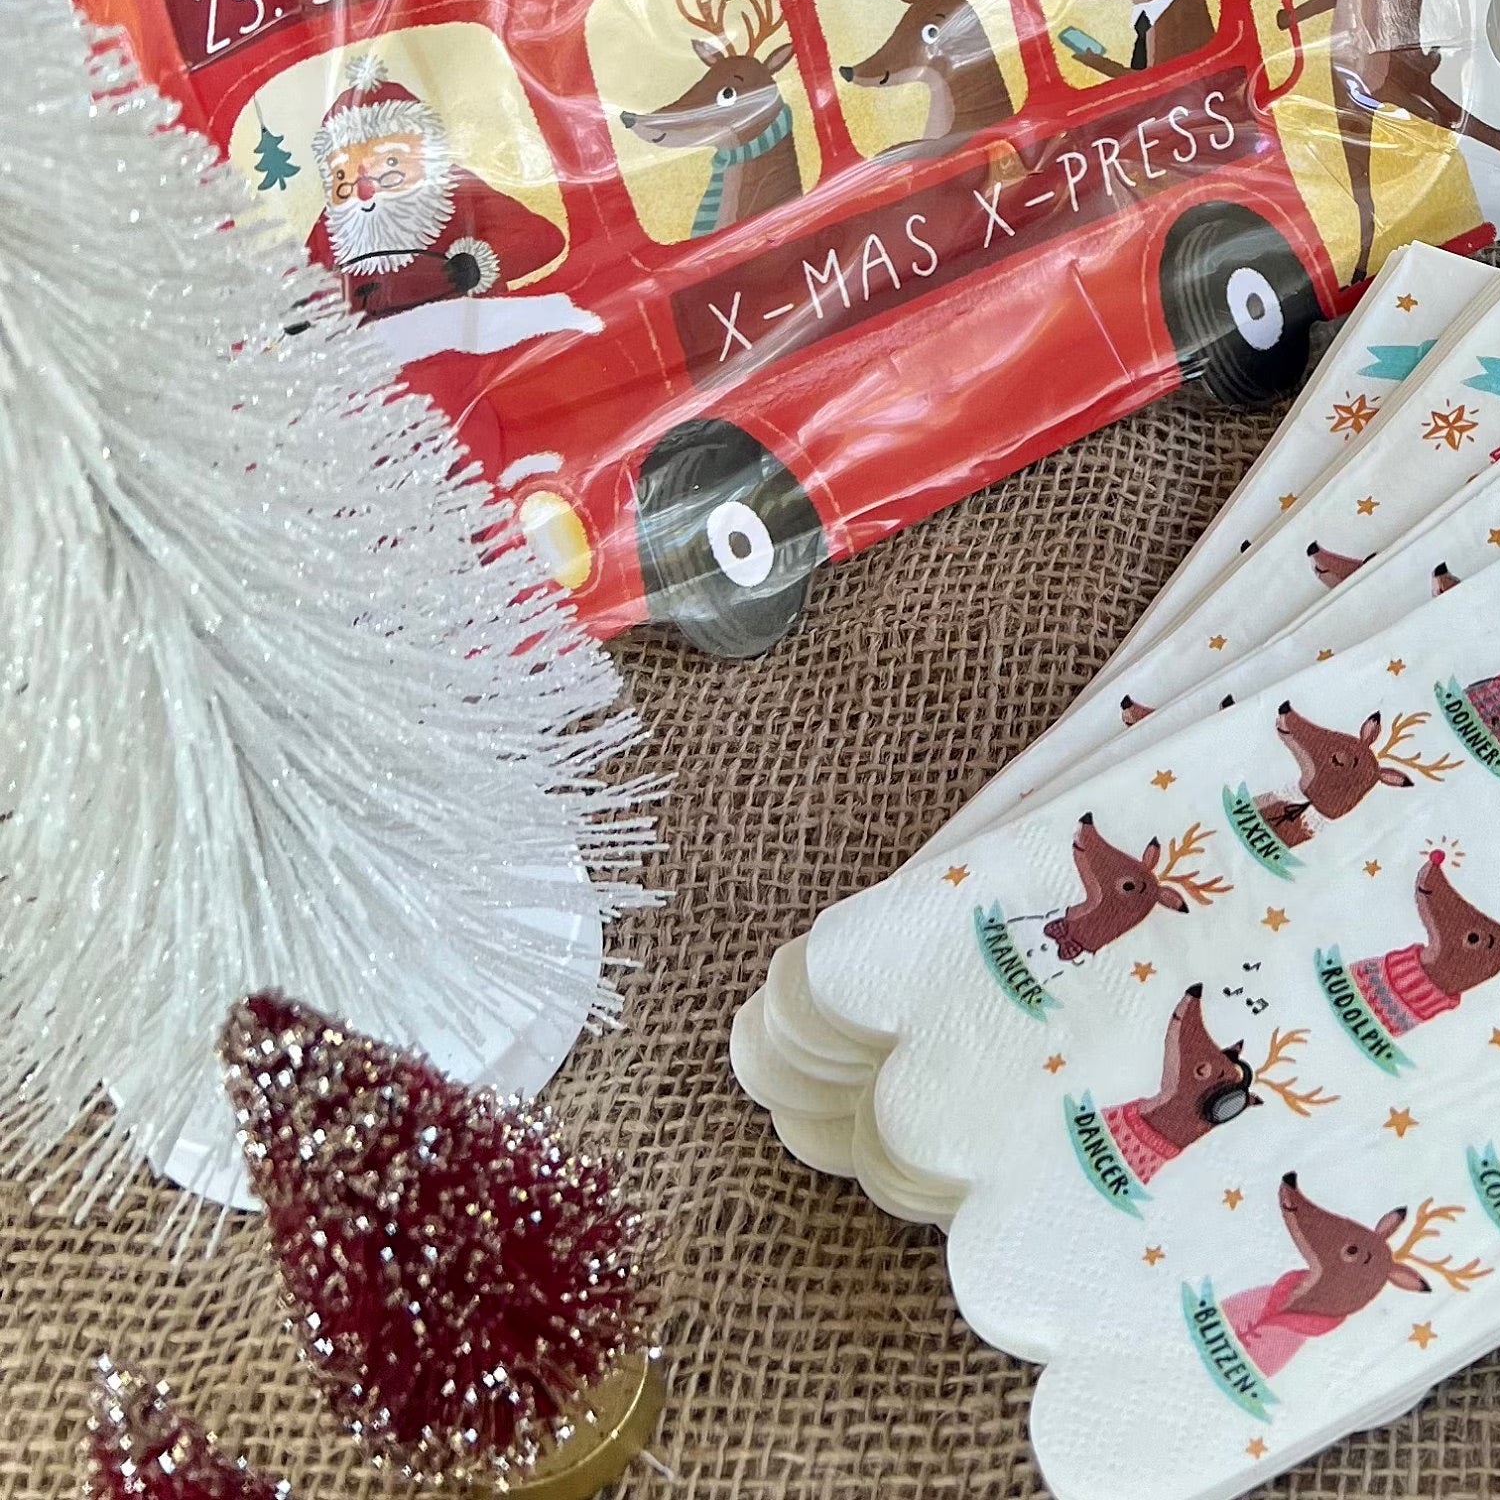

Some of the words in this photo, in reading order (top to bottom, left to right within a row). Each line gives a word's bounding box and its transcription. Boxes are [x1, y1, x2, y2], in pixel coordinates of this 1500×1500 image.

[708, 213, 939, 364] X-MAS
[981, 89, 1238, 251] X-PRESS
[1445, 699, 1499, 766] DONNER
[1233, 802, 1278, 859] VIXEN
[1321, 963, 1391, 1059] RUDOLPH
[1075, 1110, 1128, 1196] DANCER
[1194, 1305, 1257, 1395] BLITZEN
